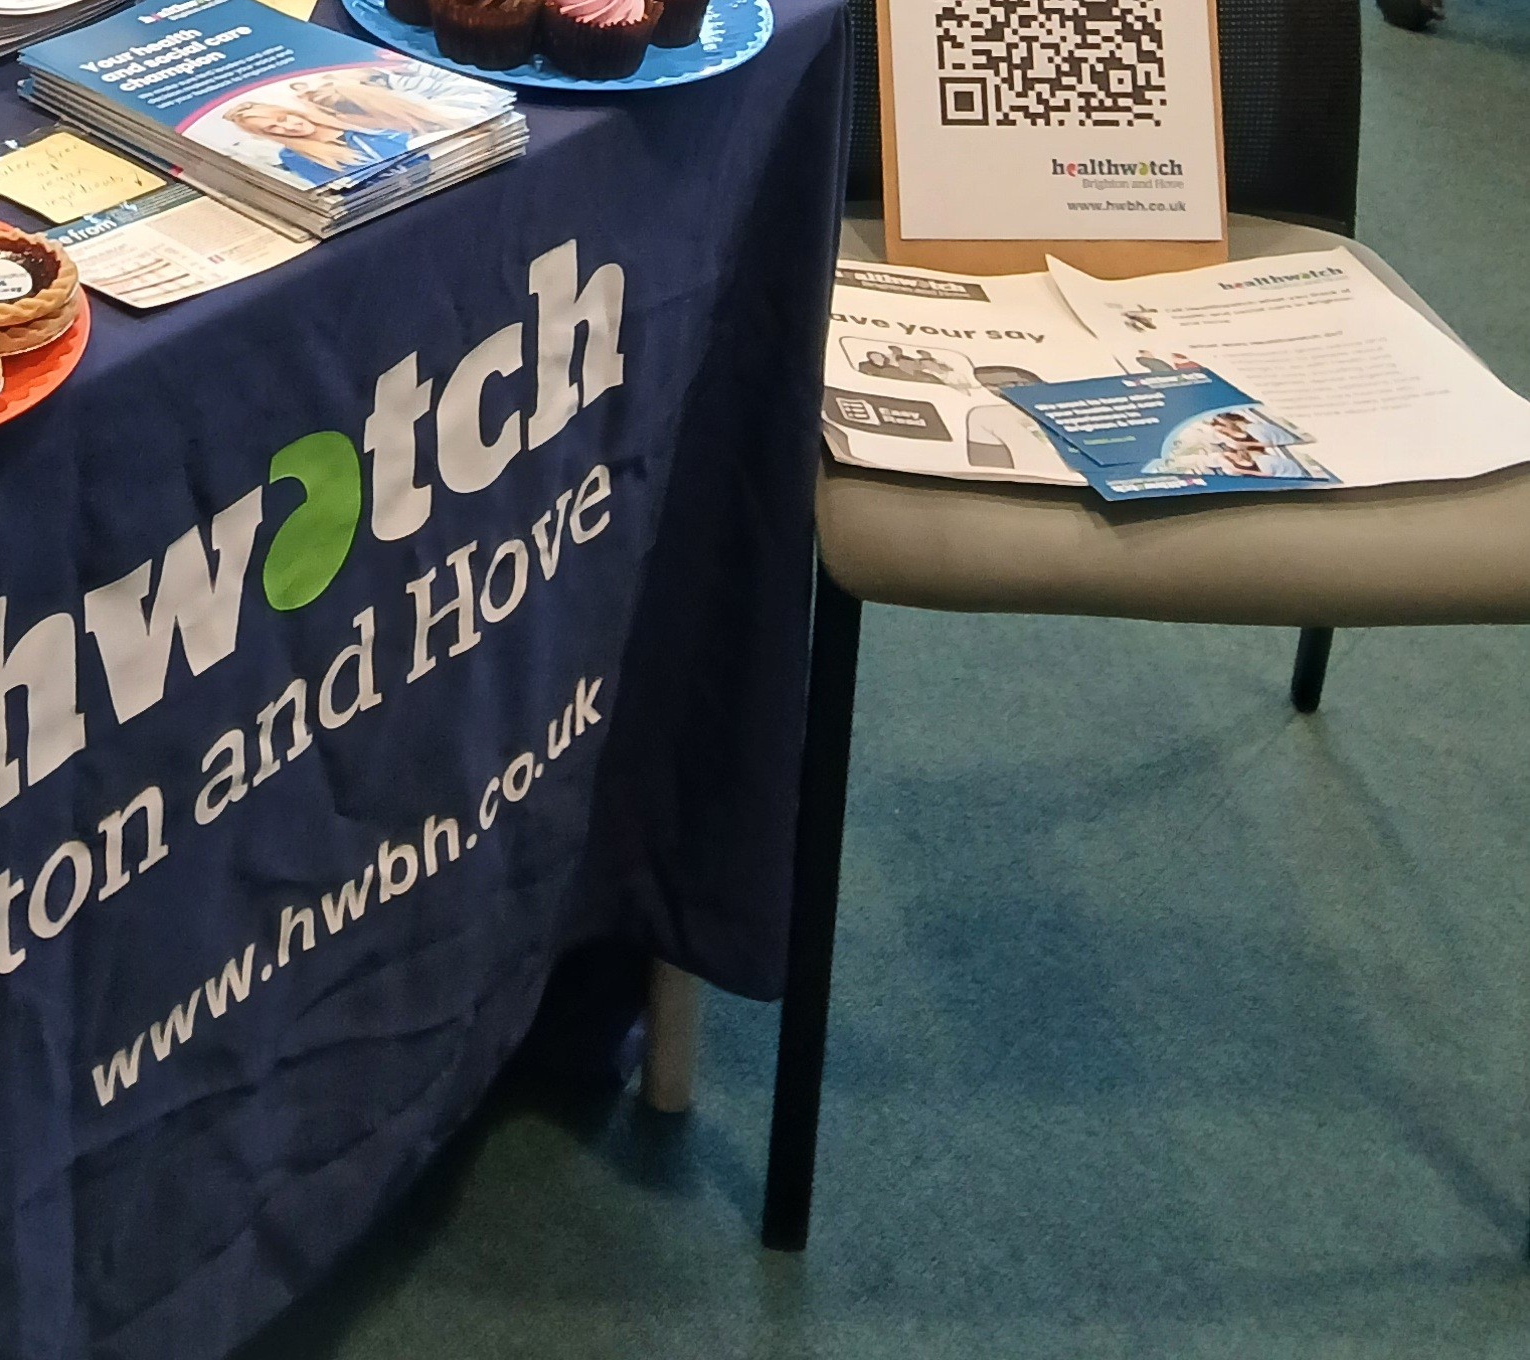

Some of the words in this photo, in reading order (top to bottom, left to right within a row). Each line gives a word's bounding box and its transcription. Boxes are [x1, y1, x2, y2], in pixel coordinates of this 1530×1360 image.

[79, 49, 133, 74] Your
[129, 28, 203, 59] health
[101, 64, 147, 83] and
[143, 41, 207, 69] social
[203, 26, 253, 47] care
[119, 50, 228, 93] champion
[1051, 158, 1184, 177] healthwatch
[1066, 198, 1187, 213] www.hwbh.co.uk
[1218, 265, 1344, 293] healthwatch
[829, 311, 890, 329] ave
[896, 320, 977, 340] your
[985, 328, 1046, 344] say
[191, 627, 386, 828] and
[401, 461, 616, 687] Hove
[88, 667, 606, 1108] www.hwbh.co.uk
